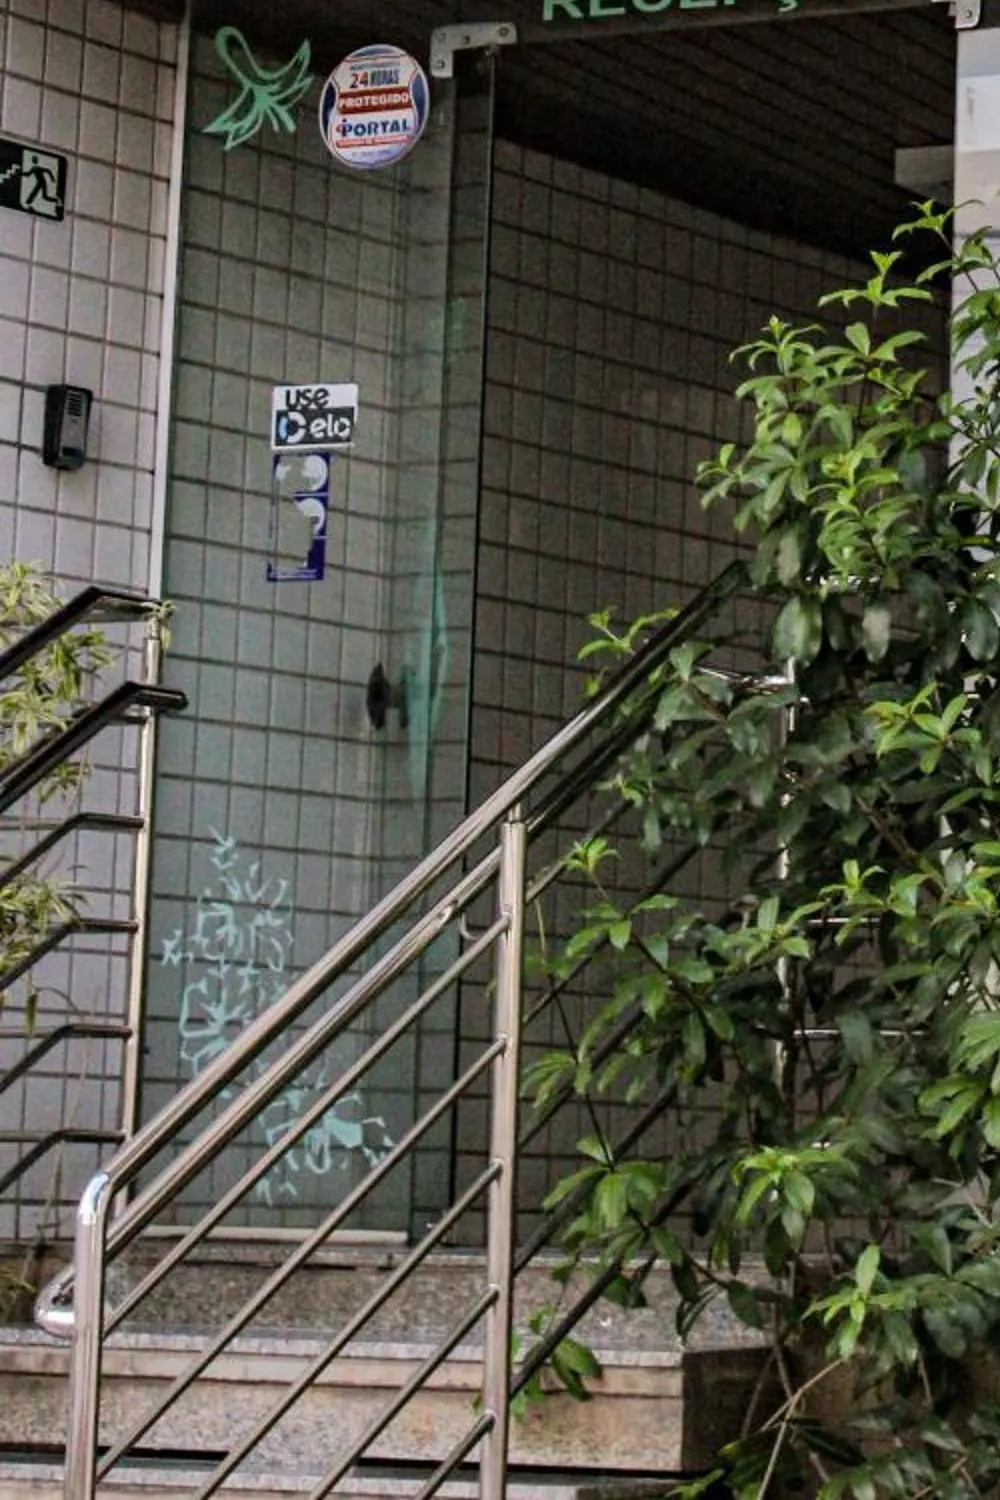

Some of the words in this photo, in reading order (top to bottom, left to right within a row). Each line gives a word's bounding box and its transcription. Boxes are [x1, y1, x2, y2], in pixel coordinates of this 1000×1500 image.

[339, 92, 409, 109] PROTEGIDO
[338, 118, 410, 137] PORTAL
[285, 387, 329, 411] use
[310, 418, 350, 439] elo
